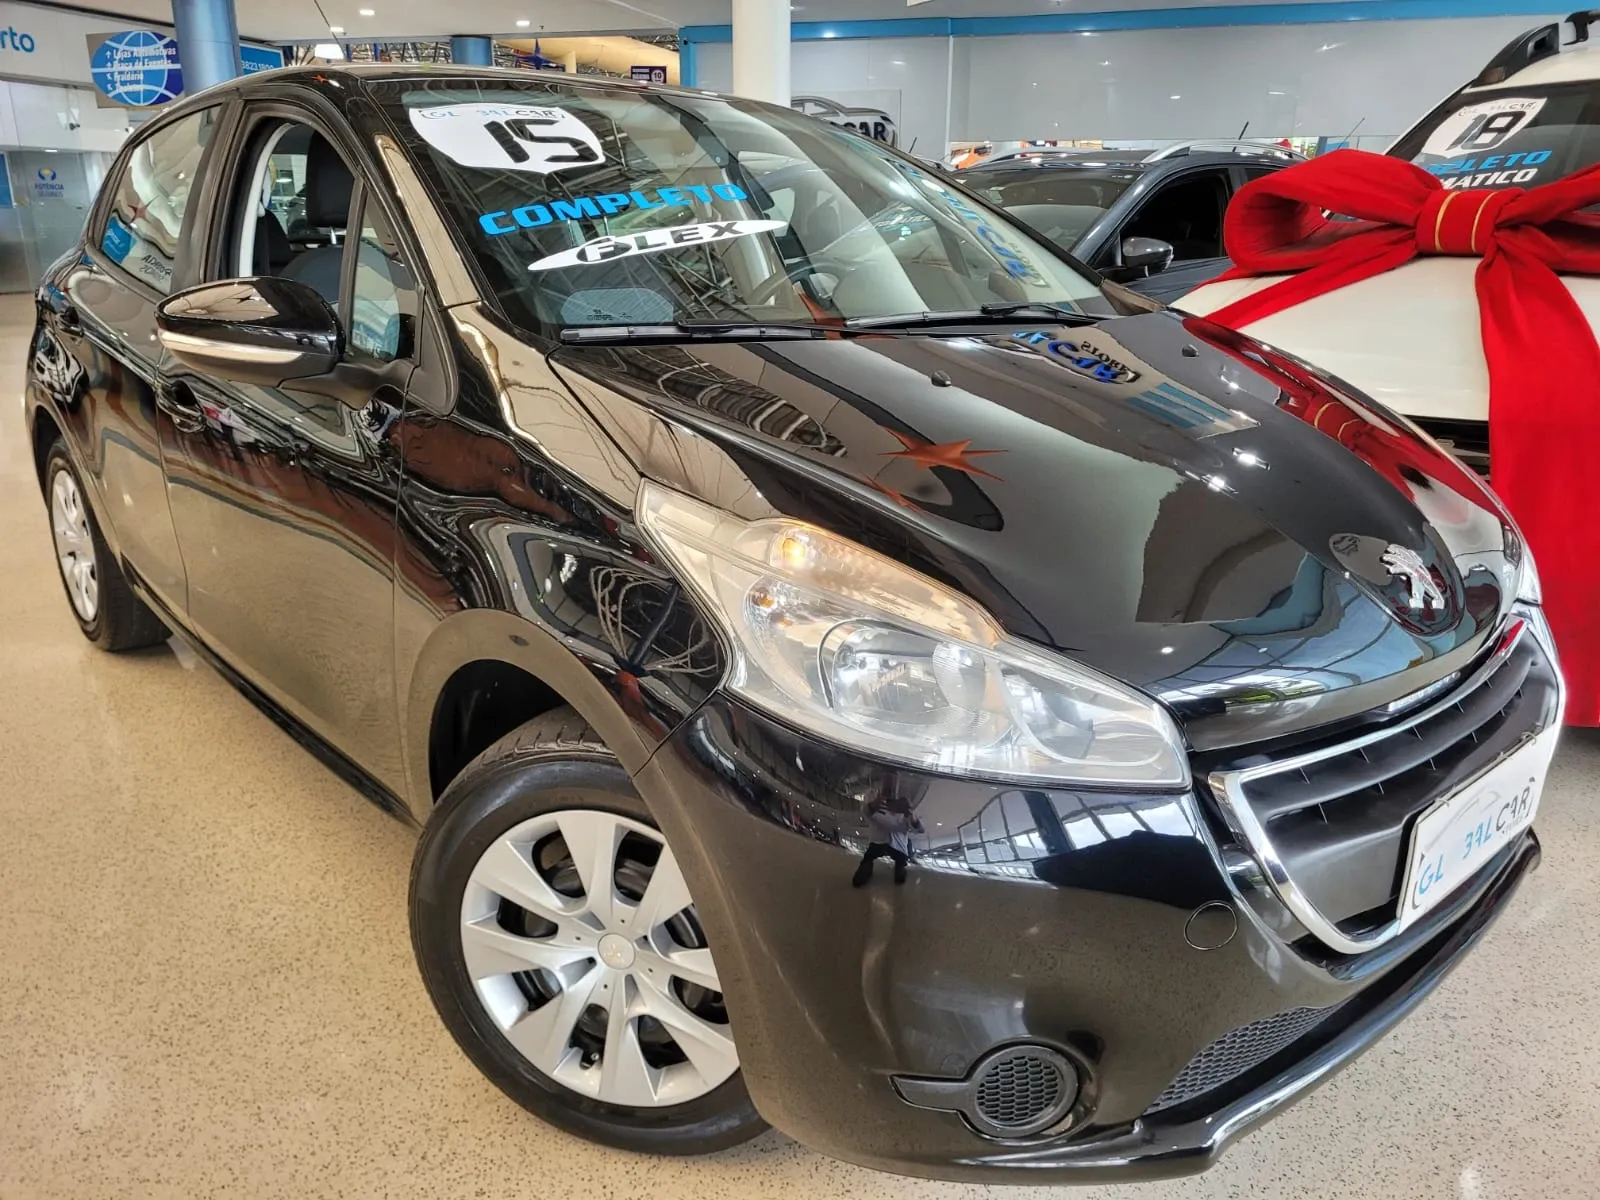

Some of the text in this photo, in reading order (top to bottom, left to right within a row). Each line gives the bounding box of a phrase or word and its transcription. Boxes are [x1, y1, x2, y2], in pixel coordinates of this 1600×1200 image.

[483, 118, 600, 164] 15
[1445, 110, 1527, 150] 18
[1424, 150, 1553, 176] PLETO
[1439, 168, 1539, 190] MATICO
[478, 184, 748, 235] COMPLETO
[578, 222, 743, 262] FLEX
